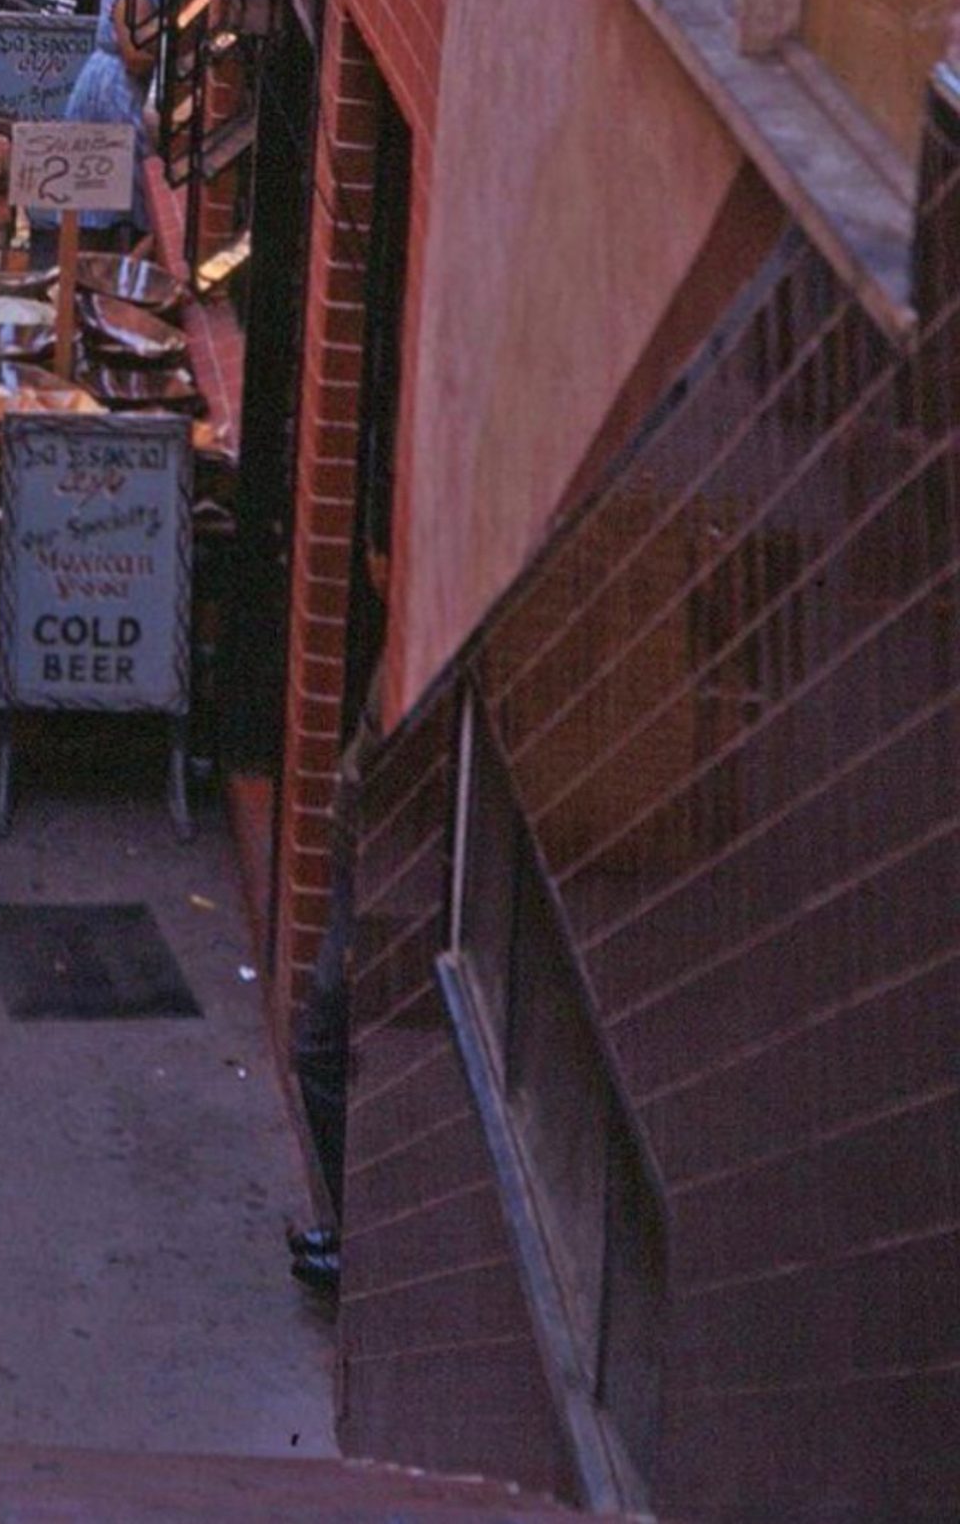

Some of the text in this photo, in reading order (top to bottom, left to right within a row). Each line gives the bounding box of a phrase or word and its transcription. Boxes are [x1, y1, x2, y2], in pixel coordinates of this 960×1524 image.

[37, 552, 156, 577] Mexican
[33, 614, 142, 648] COLD
[43, 653, 134, 684] BEER
